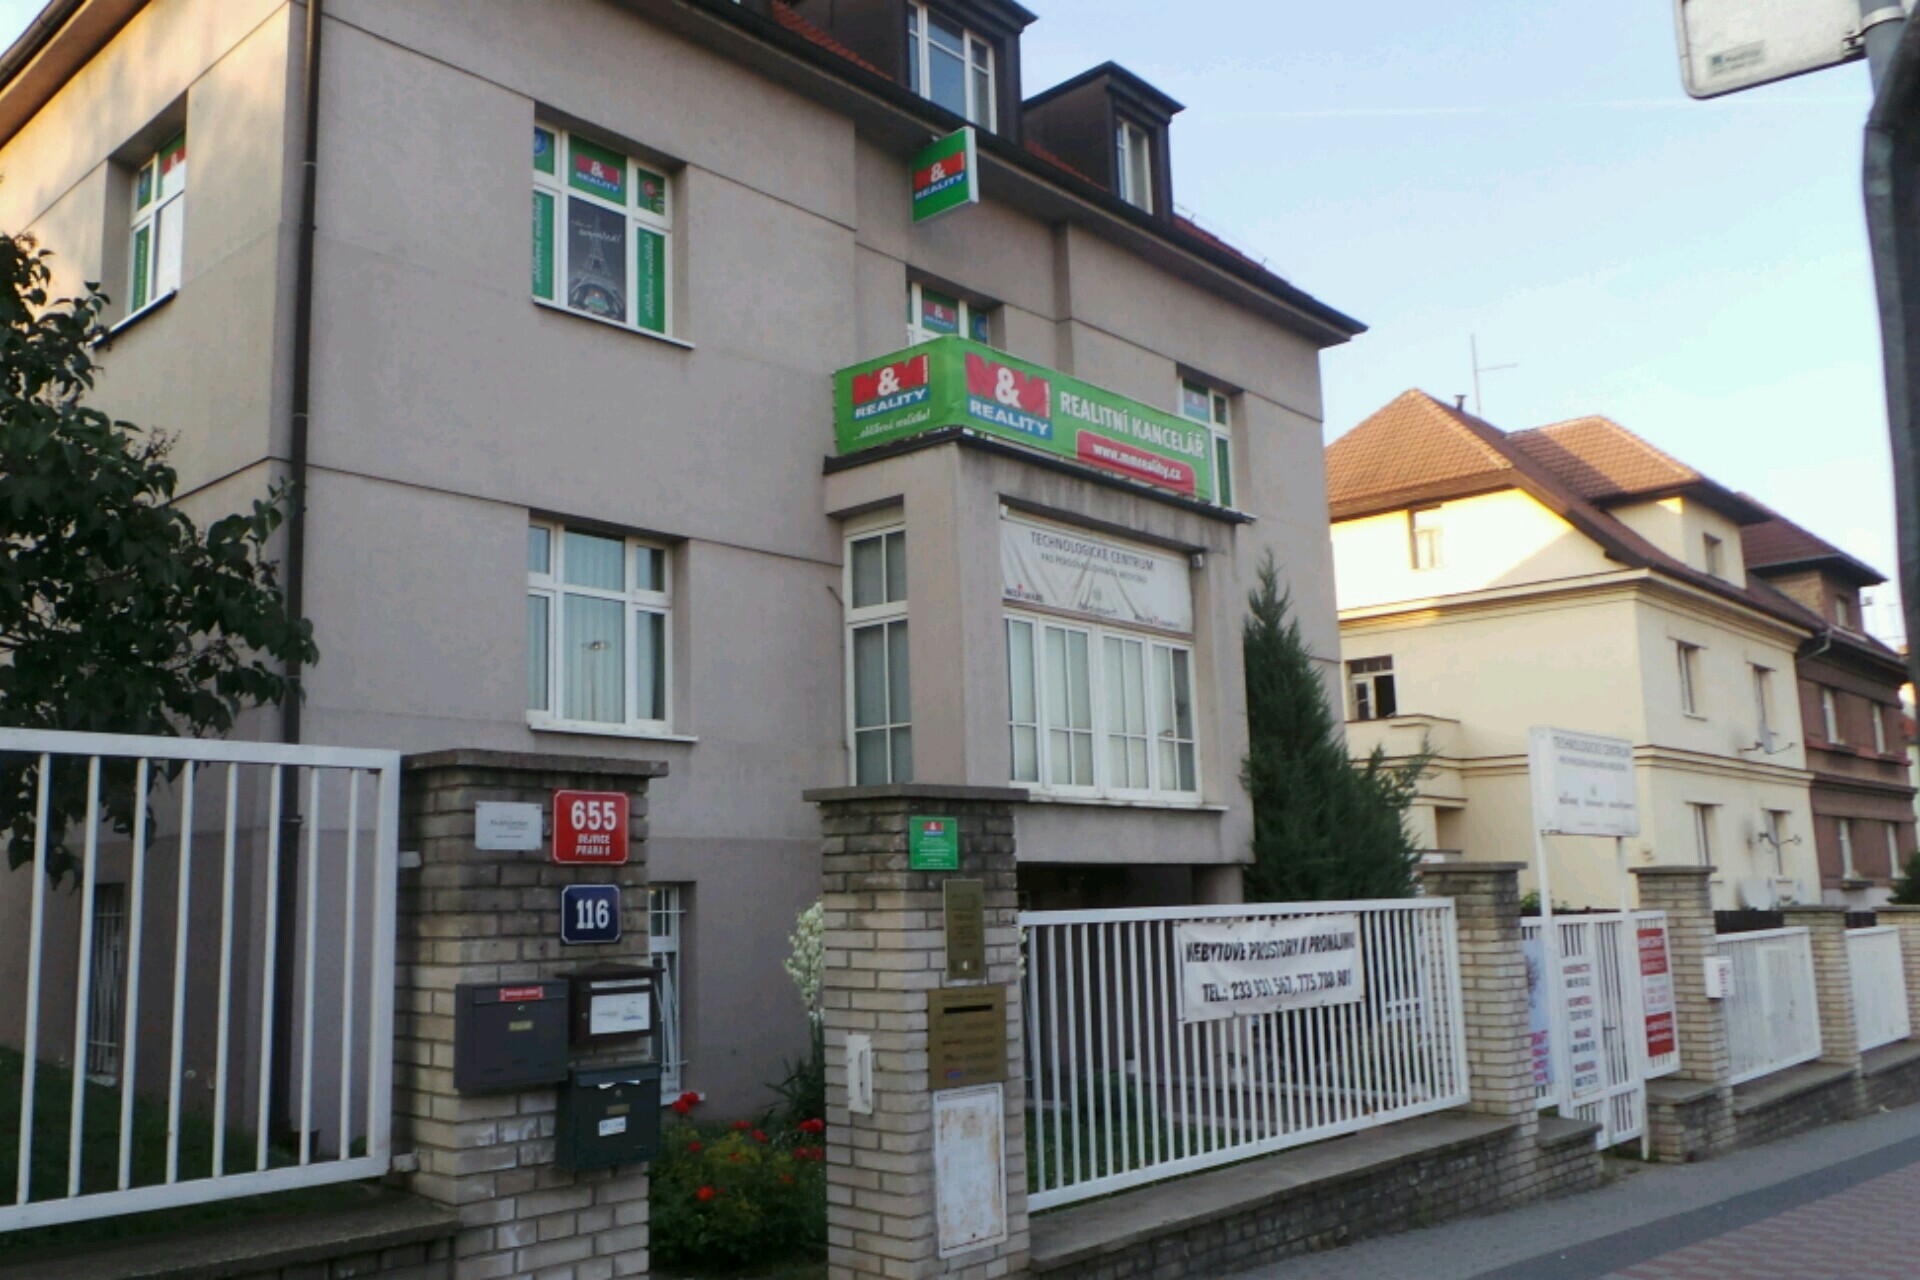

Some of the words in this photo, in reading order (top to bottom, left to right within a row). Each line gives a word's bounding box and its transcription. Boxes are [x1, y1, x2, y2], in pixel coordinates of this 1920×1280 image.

[915, 173, 963, 200] REALITY
[855, 388, 926, 419] REALITY
[970, 398, 1048, 436] REALITY
[1060, 391, 1128, 433] REALITNÍ
[1132, 417, 1205, 459] KANCELÁŘ
[571, 800, 617, 831] 655
[576, 899, 610, 930] 116
[1309, 928, 1355, 953] PRONÁJ
